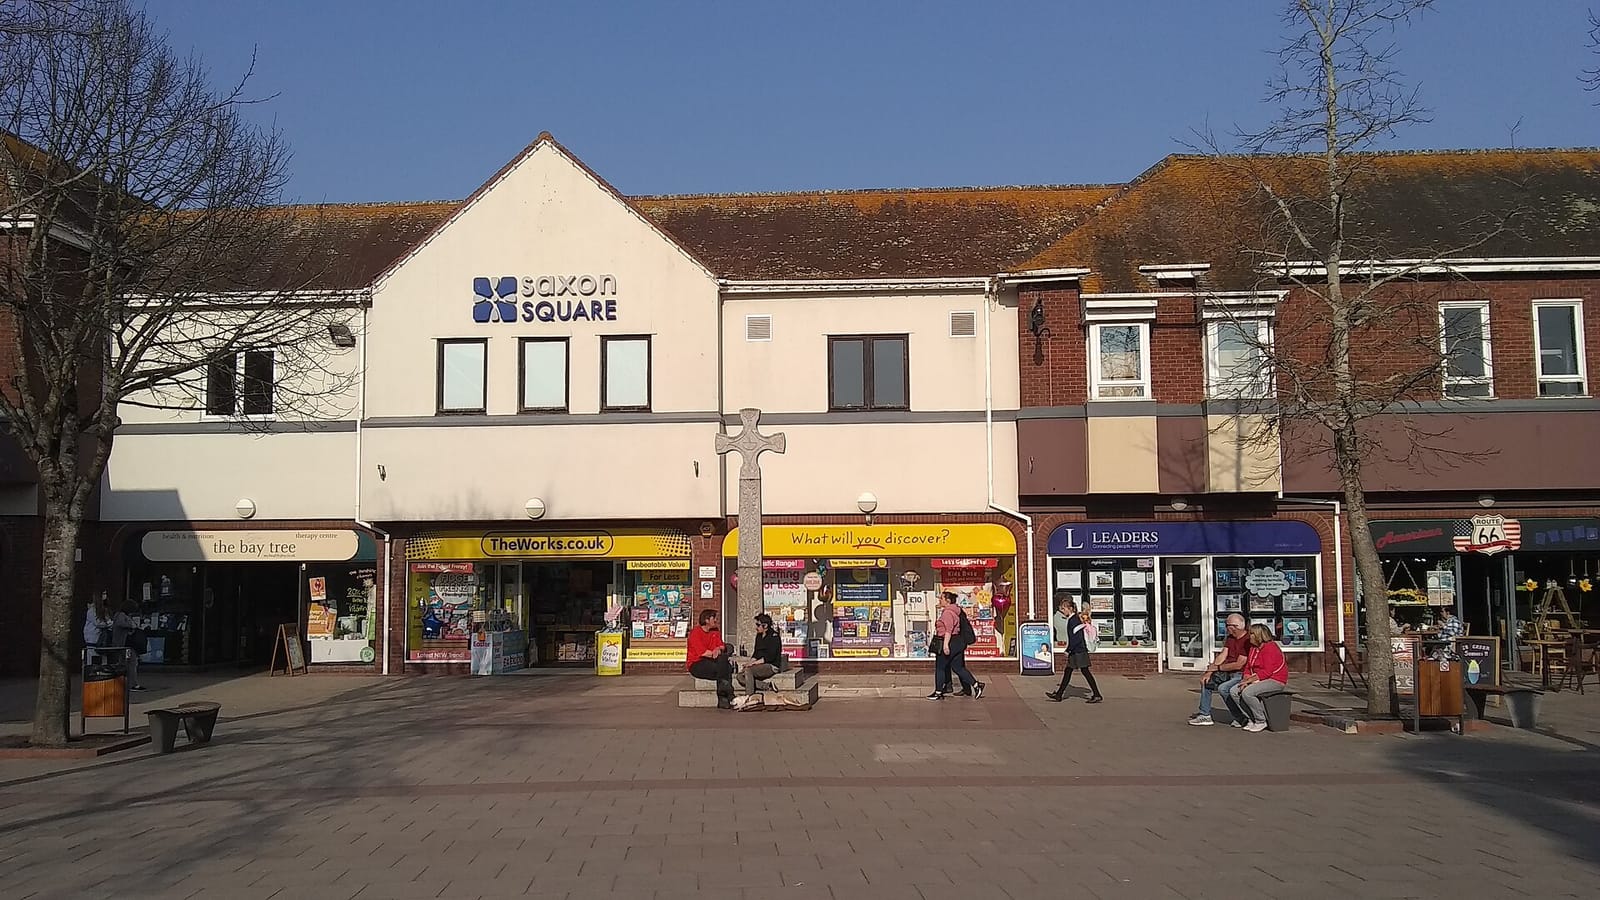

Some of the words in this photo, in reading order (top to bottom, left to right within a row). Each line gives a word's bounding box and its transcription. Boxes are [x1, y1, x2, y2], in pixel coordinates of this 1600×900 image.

[521, 274, 617, 297] saxon
[521, 300, 617, 322] SQUARE
[295, 532, 319, 541] therapy
[791, 532, 828, 545] What
[832, 531, 853, 545] will
[857, 537, 881, 549] you
[885, 529, 950, 545] discover?
[1065, 528, 1084, 549] L
[1092, 531, 1159, 543] LEADERS
[1480, 527, 1500, 544] 66
[213, 539, 236, 554] the
[240, 539, 265, 558] bay
[269, 541, 297, 554] tree
[490, 536, 605, 551] TheWorks.co.uk
[631, 561, 667, 569] Unbeatable
[775, 559, 798, 568] Range!
[649, 573, 662, 581] For
[663, 573, 680, 581] Less
[777, 581, 800, 590] Less
[1023, 629, 1049, 637] Sellology
